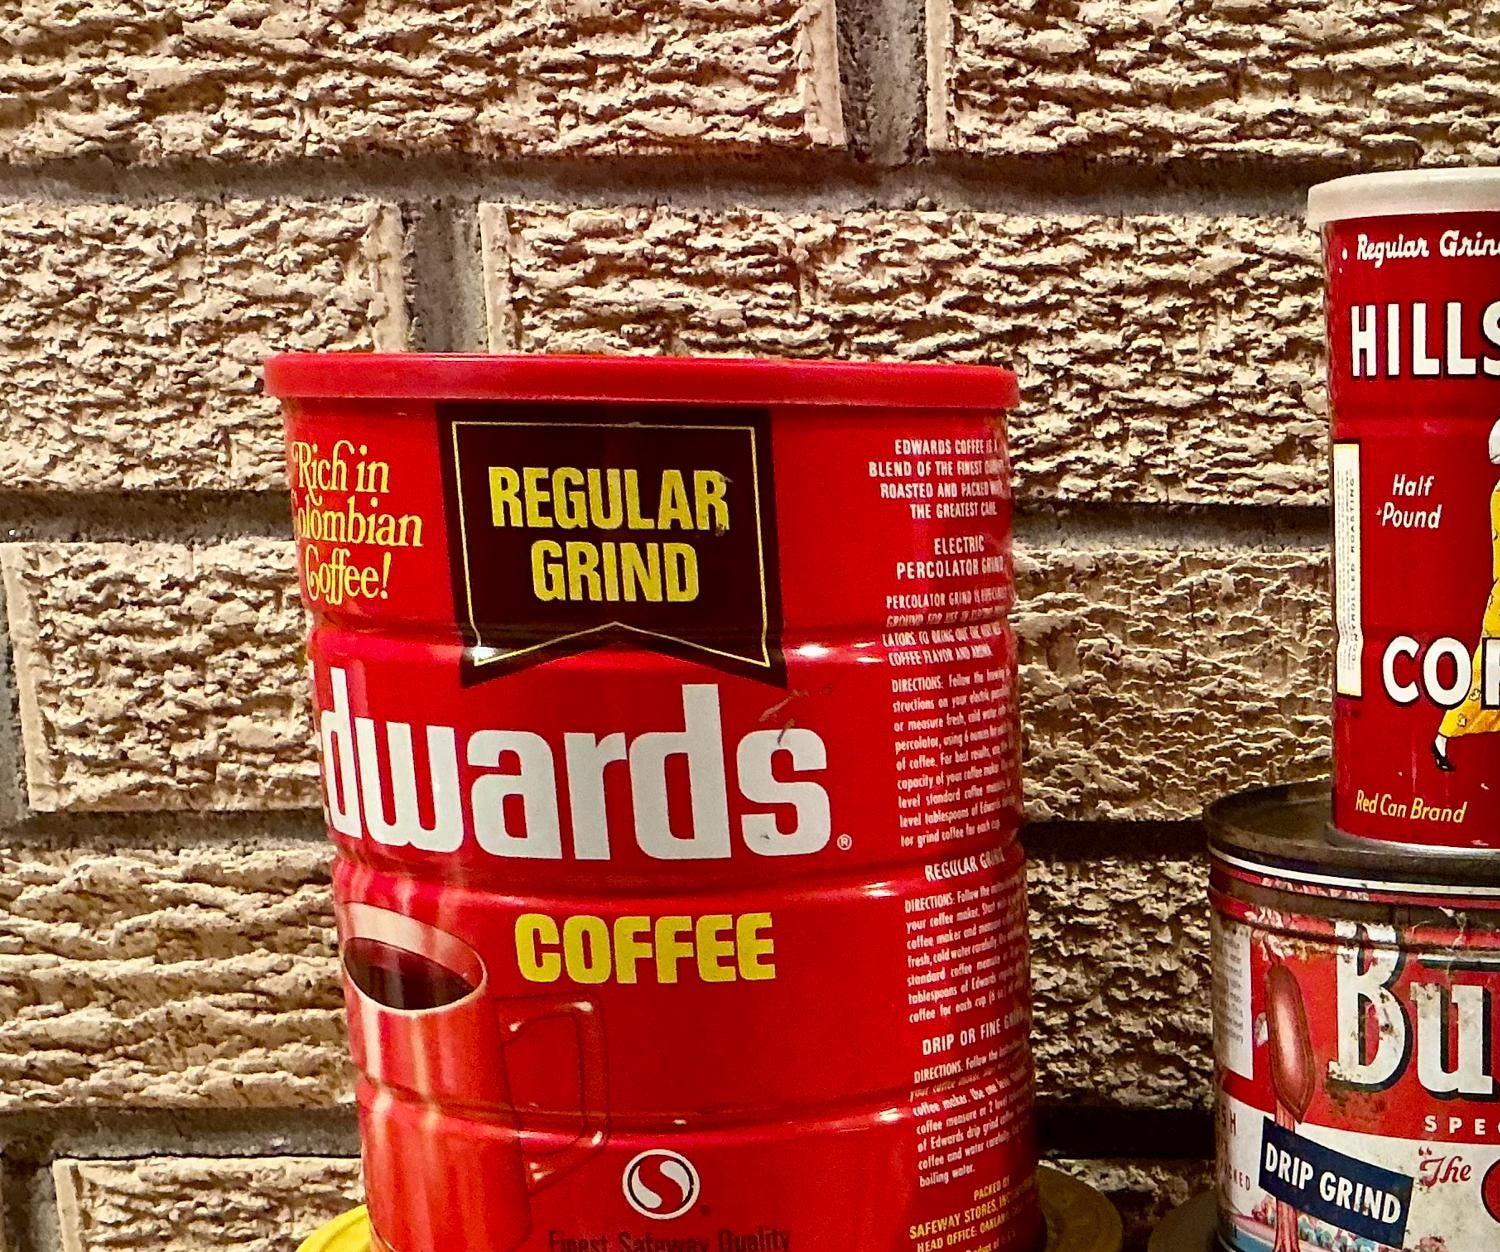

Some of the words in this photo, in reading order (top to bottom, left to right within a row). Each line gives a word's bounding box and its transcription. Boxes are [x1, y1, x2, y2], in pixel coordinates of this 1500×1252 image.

[1357, 233, 1430, 268] Regular
[895, 439, 951, 455] EDWARDS
[291, 440, 355, 500] Rich
[355, 445, 390, 493] in
[868, 461, 912, 477] BLEND
[917, 461, 932, 477] OF
[935, 461, 953, 476] THE
[488, 466, 731, 531] REGULAR
[880, 482, 933, 498] ROASTED
[937, 482, 957, 497] AND
[1392, 474, 1434, 496] Half
[910, 504, 931, 519] THE
[936, 502, 978, 518] GREATEST
[1382, 503, 1442, 530] Pound
[934, 535, 985, 555] ELECTRIC
[305, 544, 392, 604] Coffee!
[531, 539, 700, 603] GRIND
[896, 559, 979, 580] PERCOLATOR
[320, 667, 832, 861] dwards
[1355, 790, 1379, 813] Red
[1380, 796, 1407, 819] Can
[1412, 799, 1467, 824] Brand
[925, 856, 978, 882] REGULAR
[515, 913, 776, 984] COFFEE
[922, 1034, 954, 1055] DRIP
[960, 1028, 976, 1046] OR
[980, 1018, 1000, 1040] FINE
[1265, 1142, 1314, 1190] DRIP
[1319, 1171, 1401, 1224] GRIND
[909, 1213, 960, 1239] SAFEWAY
